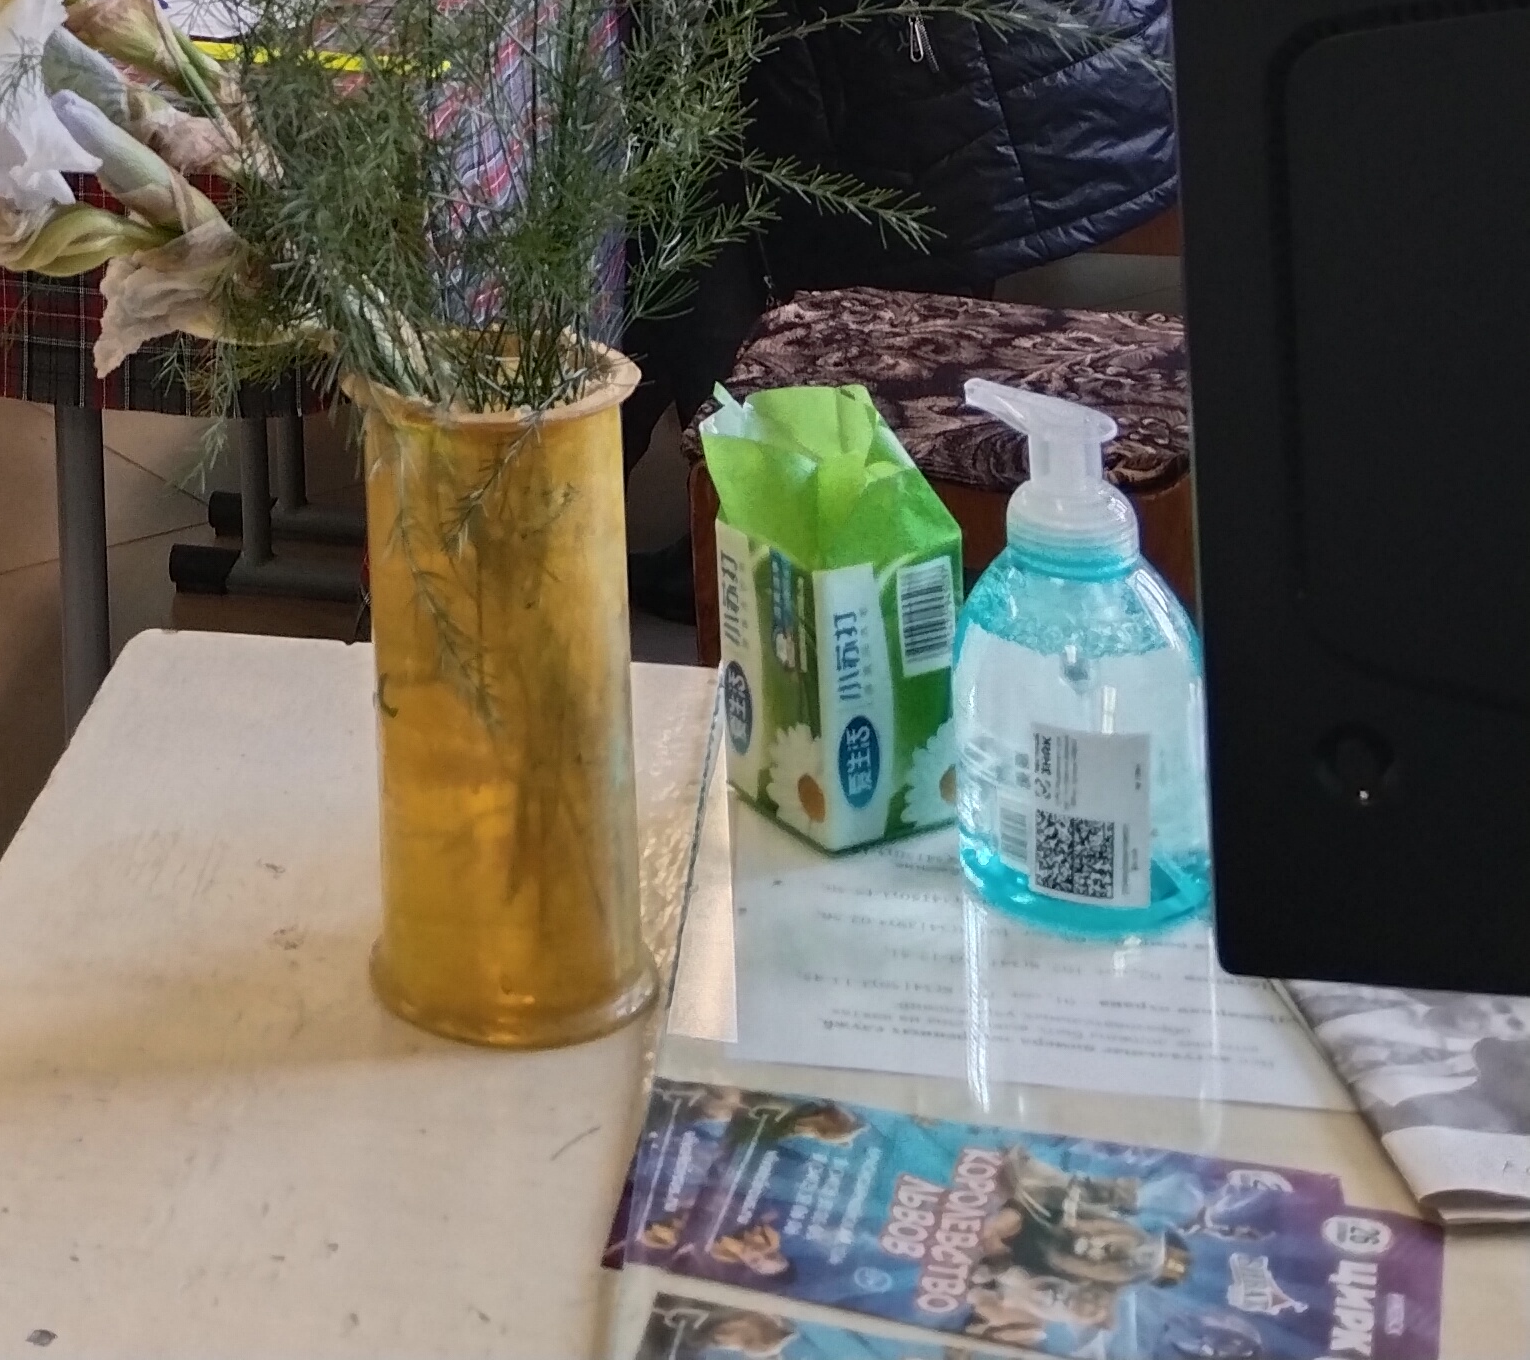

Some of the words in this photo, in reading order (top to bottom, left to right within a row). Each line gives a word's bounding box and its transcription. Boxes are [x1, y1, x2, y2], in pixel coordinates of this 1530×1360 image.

[833, 611, 861, 701] 小苏打
[881, 1174, 947, 1259] ЛЬВОВ
[916, 1148, 1003, 1314] КОРОЛЕВСТВО
[1328, 1259, 1378, 1356] ЦИРК
